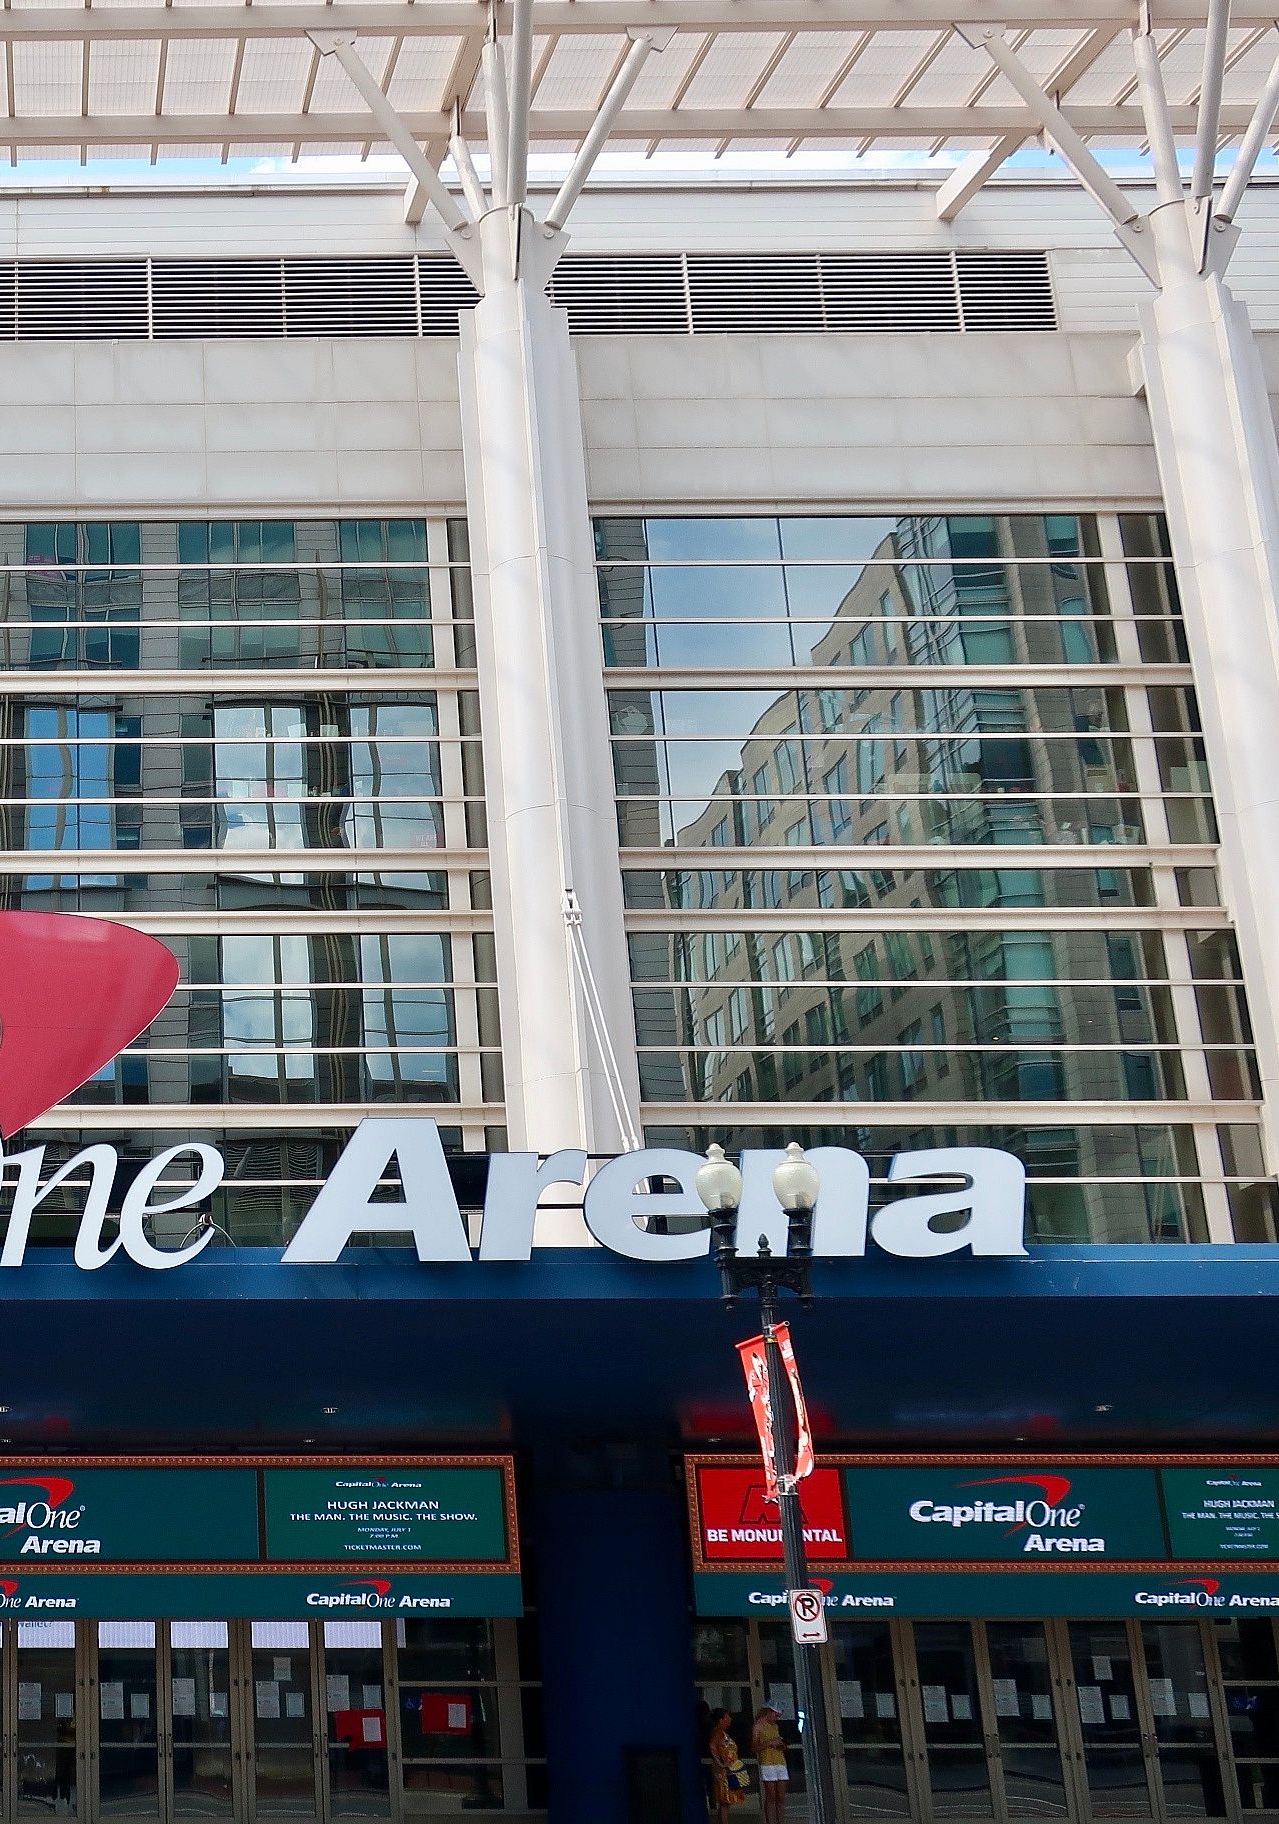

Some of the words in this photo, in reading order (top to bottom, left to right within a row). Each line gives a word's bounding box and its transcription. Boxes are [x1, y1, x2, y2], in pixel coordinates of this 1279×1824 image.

[280, 1117, 1029, 1262] Arena
[327, 1501, 368, 1510] HUGH
[372, 1501, 439, 1510] JACKMAN
[290, 1513, 311, 1521] THE
[314, 1513, 345, 1521] MAN.
[349, 1513, 370, 1521] THE
[372, 1513, 413, 1521] MUSIC.
[416, 1513, 438, 1521] THE
[440, 1513, 478, 1521] SHOW.
[706, 1529, 729, 1542] BE
[731, 1529, 843, 1542] MONUNTAL
[20, 1536, 101, 1554] Arena
[1023, 1535, 1105, 1552] Arena
[24, 1595, 77, 1608] Arena
[398, 1595, 451, 1608] Arena
[842, 1594, 894, 1607] Arena
